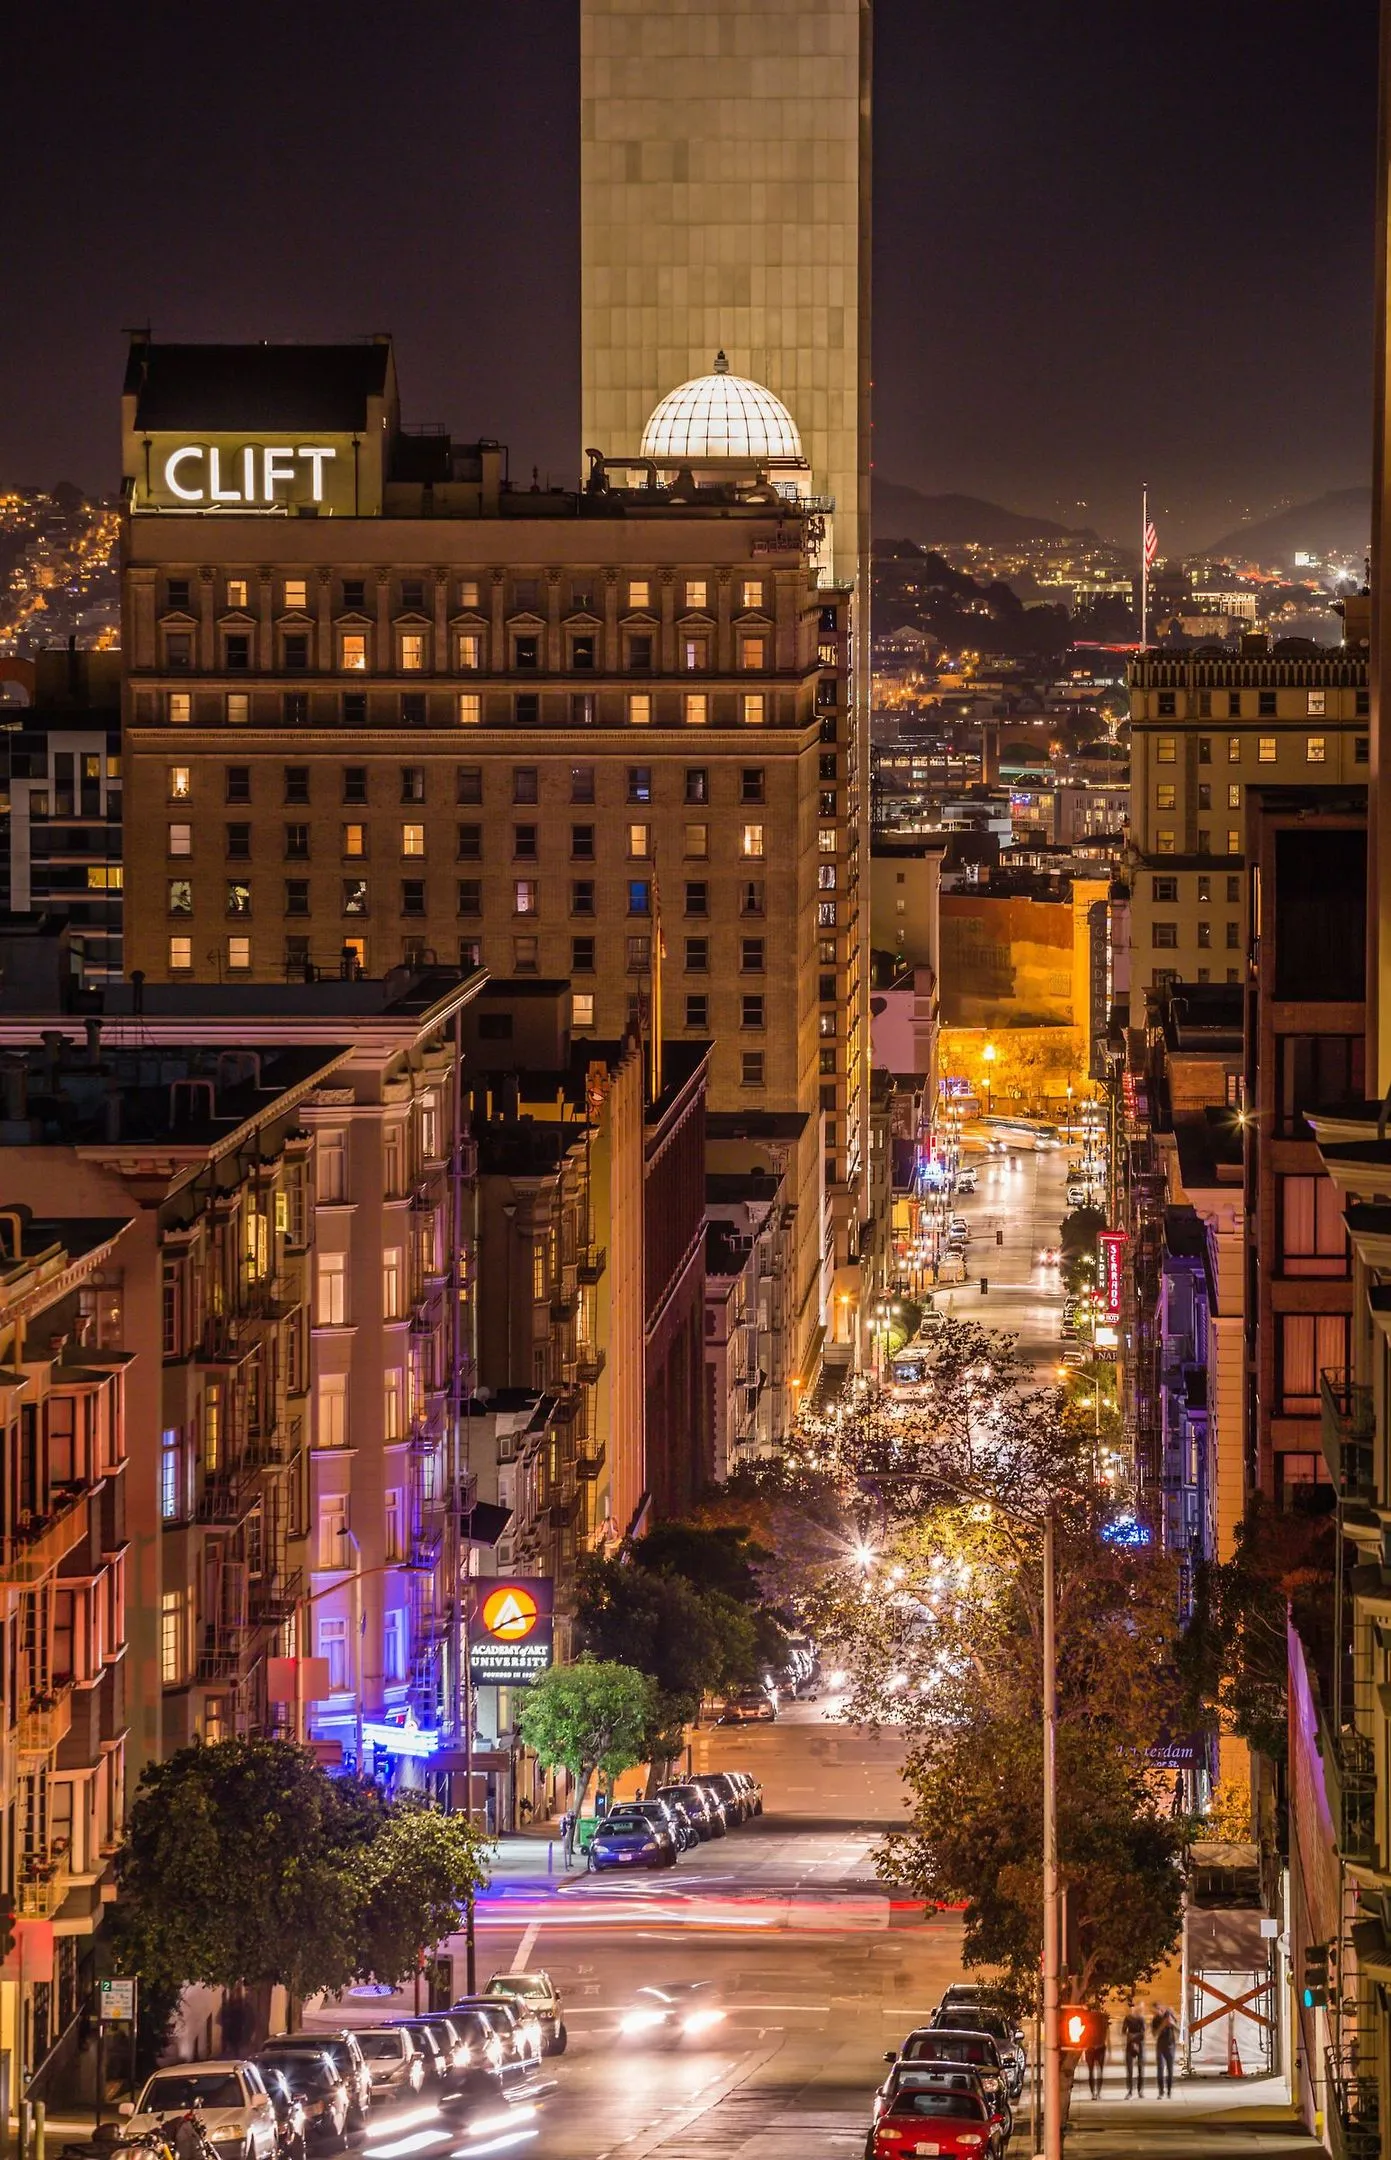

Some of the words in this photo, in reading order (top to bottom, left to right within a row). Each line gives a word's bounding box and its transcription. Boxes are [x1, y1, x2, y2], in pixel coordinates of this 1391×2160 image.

[164, 447, 336, 501] CLIFT
[471, 1645, 521, 1655] ACADEMY
[527, 1646, 548, 1655] ART
[471, 1656, 548, 1667] UNIVERSITY
[1167, 1760, 1179, 1768] St.
[104, 1982, 110, 1991] 2
